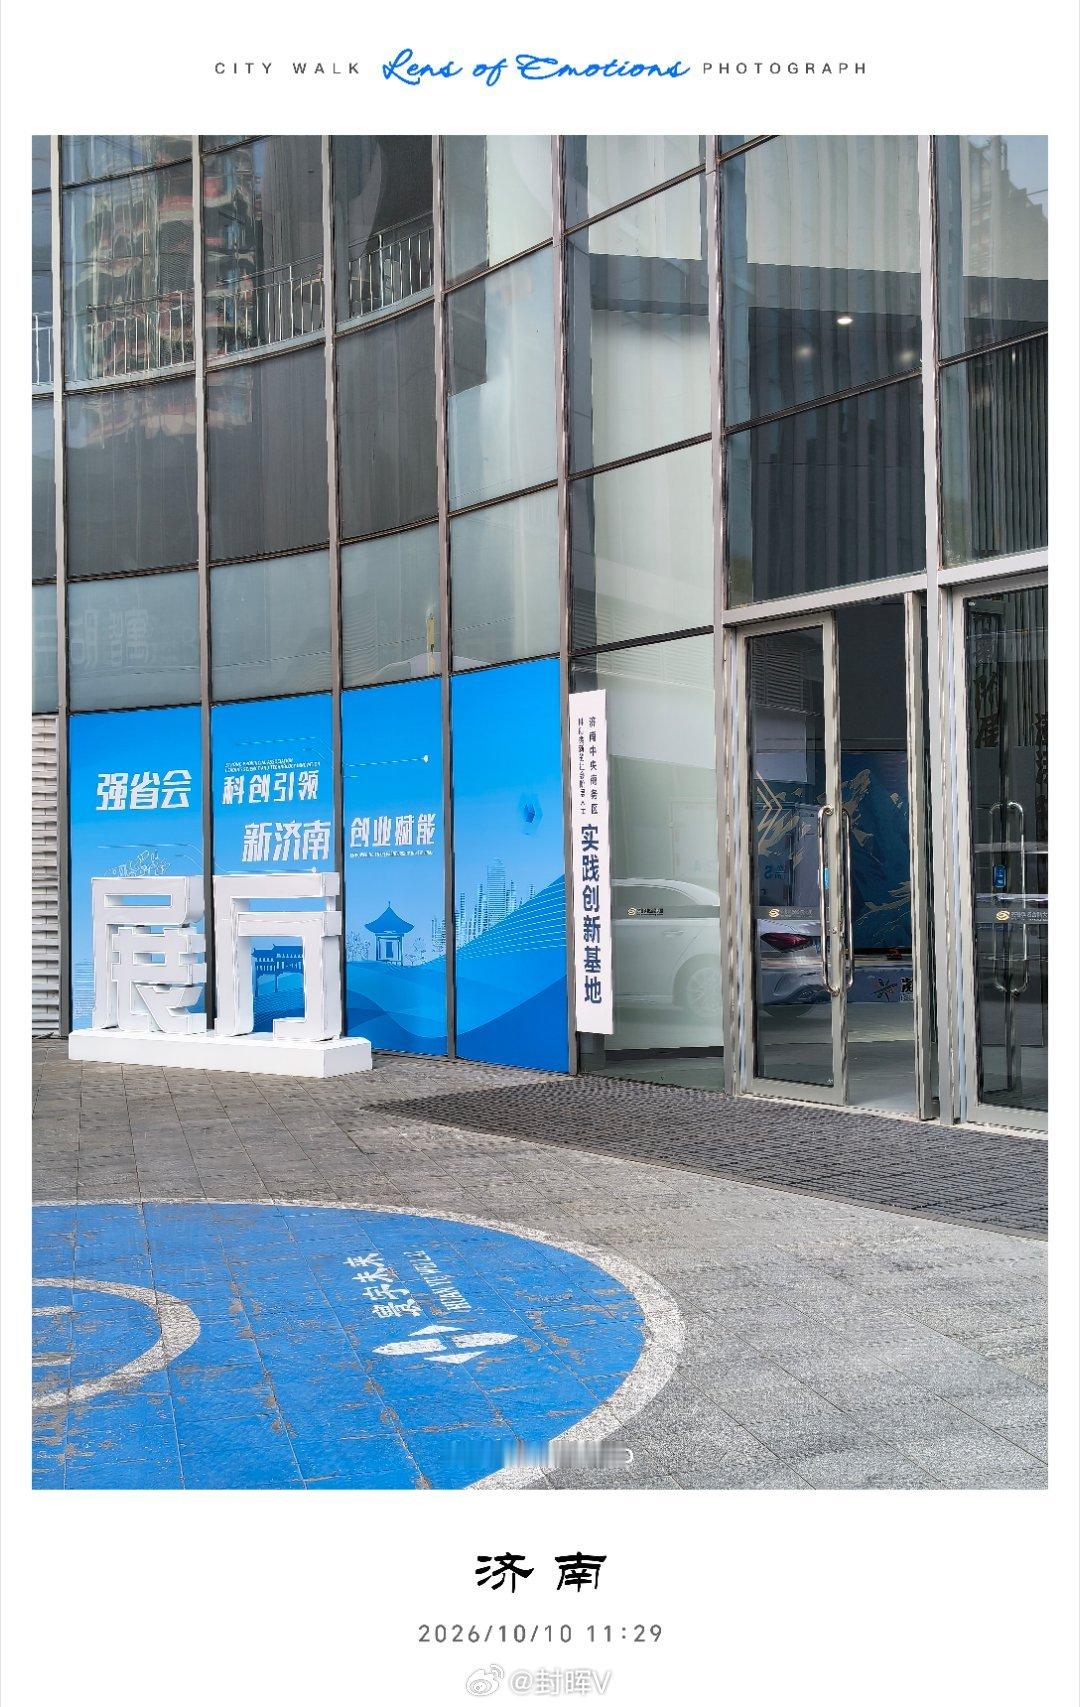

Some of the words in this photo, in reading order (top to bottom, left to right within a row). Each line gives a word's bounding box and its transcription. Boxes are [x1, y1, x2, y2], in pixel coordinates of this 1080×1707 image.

[96, 769, 193, 811] 强省会
[222, 769, 319, 805] 科创引领
[241, 819, 331, 863] 新济南
[350, 813, 437, 848] 创业赋能
[581, 823, 603, 1004] 实践创新基地
[91, 872, 341, 1042] 展厅
